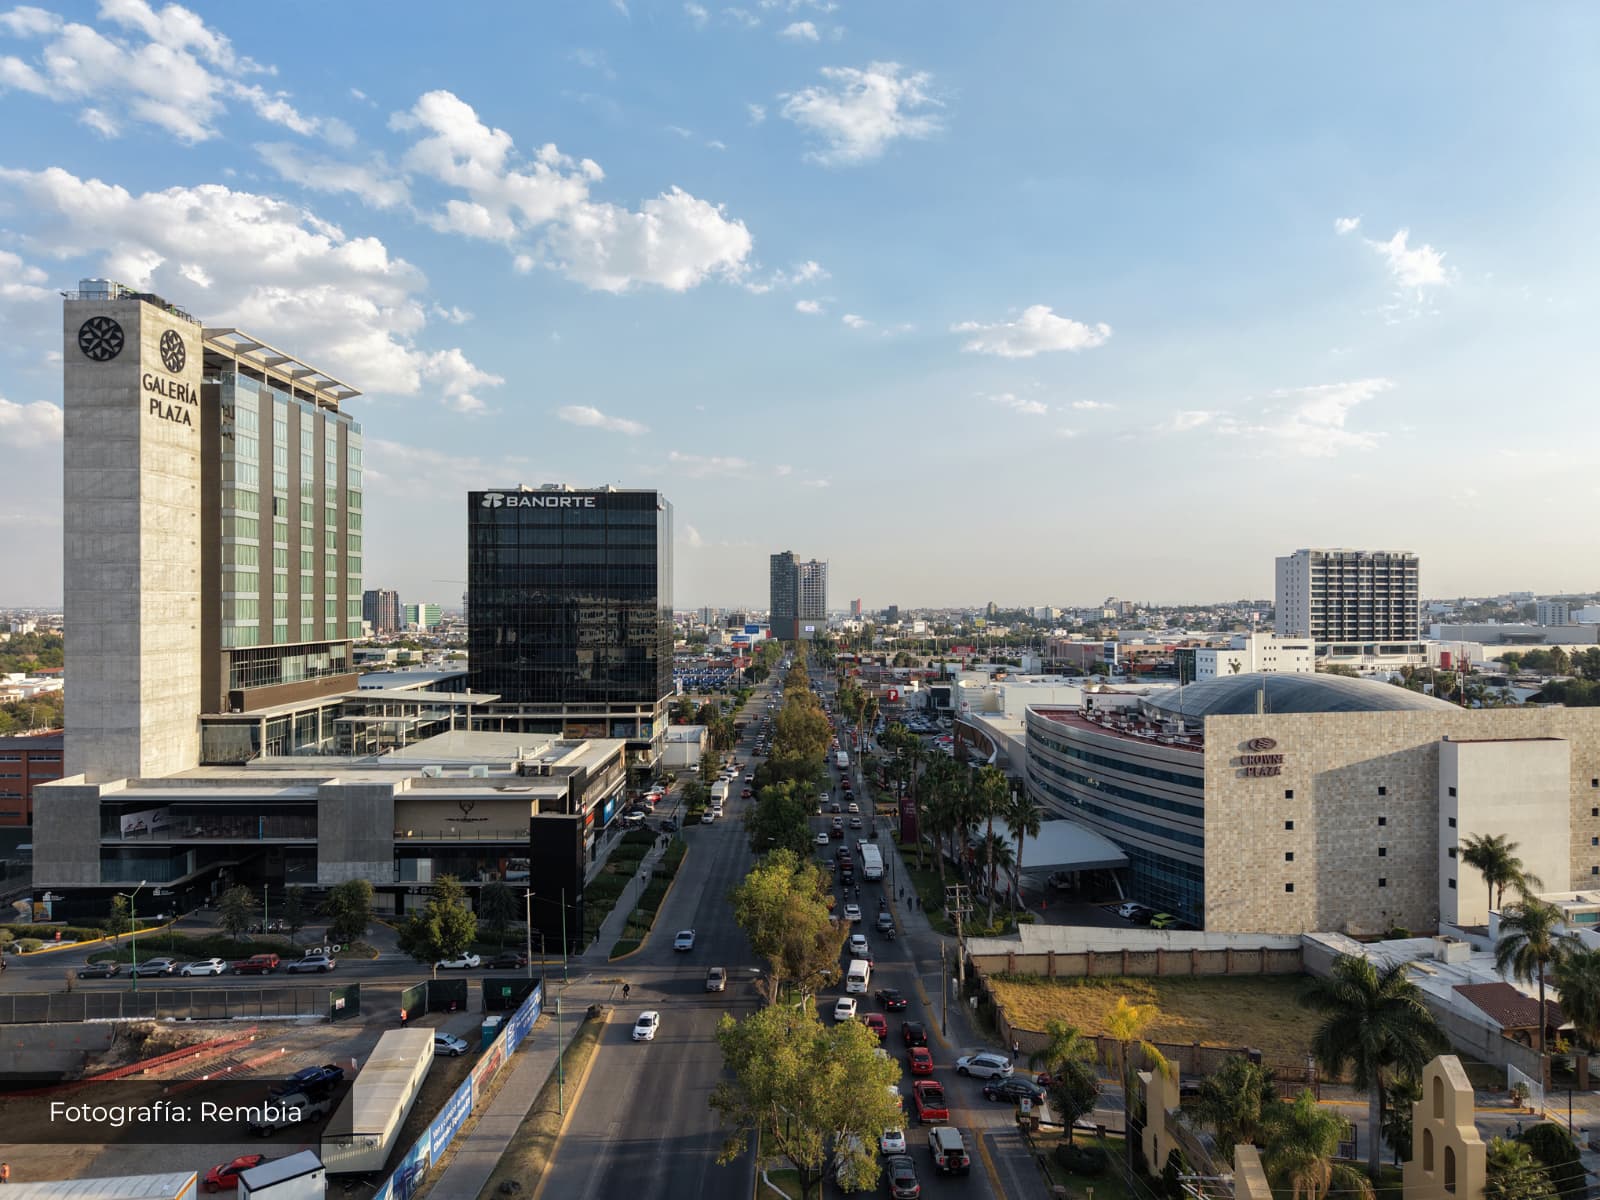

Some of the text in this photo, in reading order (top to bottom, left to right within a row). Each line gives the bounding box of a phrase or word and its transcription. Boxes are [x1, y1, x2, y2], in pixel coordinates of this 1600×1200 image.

[142, 373, 199, 407] GALERÍA
[149, 398, 192, 427] PLAZA
[506, 496, 596, 508] BANORTE
[1246, 766, 1282, 777] PLAZA
